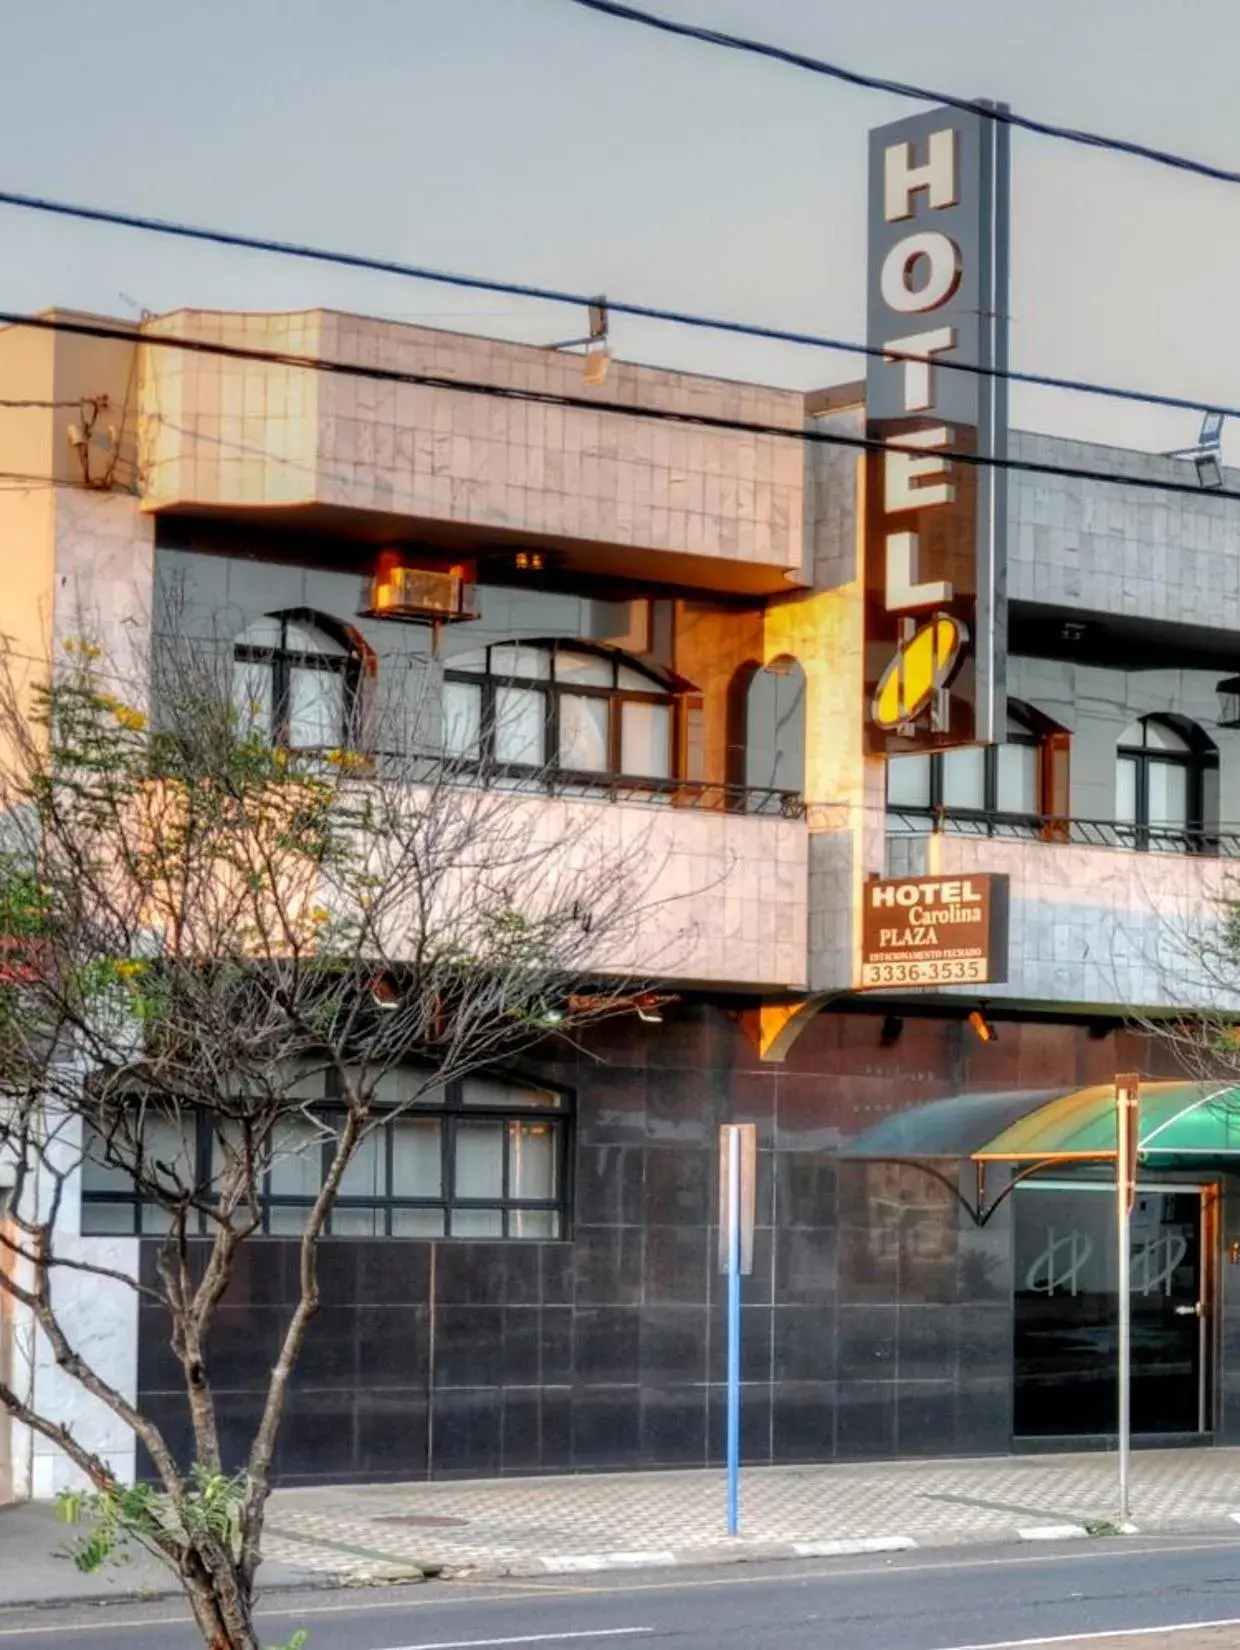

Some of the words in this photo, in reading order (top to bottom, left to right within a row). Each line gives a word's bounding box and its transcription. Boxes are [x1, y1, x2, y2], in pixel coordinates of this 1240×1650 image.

[881, 128, 960, 612] HOTEL
[872, 881, 982, 908] HOTEL
[909, 904, 981, 926] Carolina
[879, 927, 938, 948] PLAZA
[870, 950, 941, 962] ESTACIONAMENTO
[870, 961, 979, 982] 3336-3535
